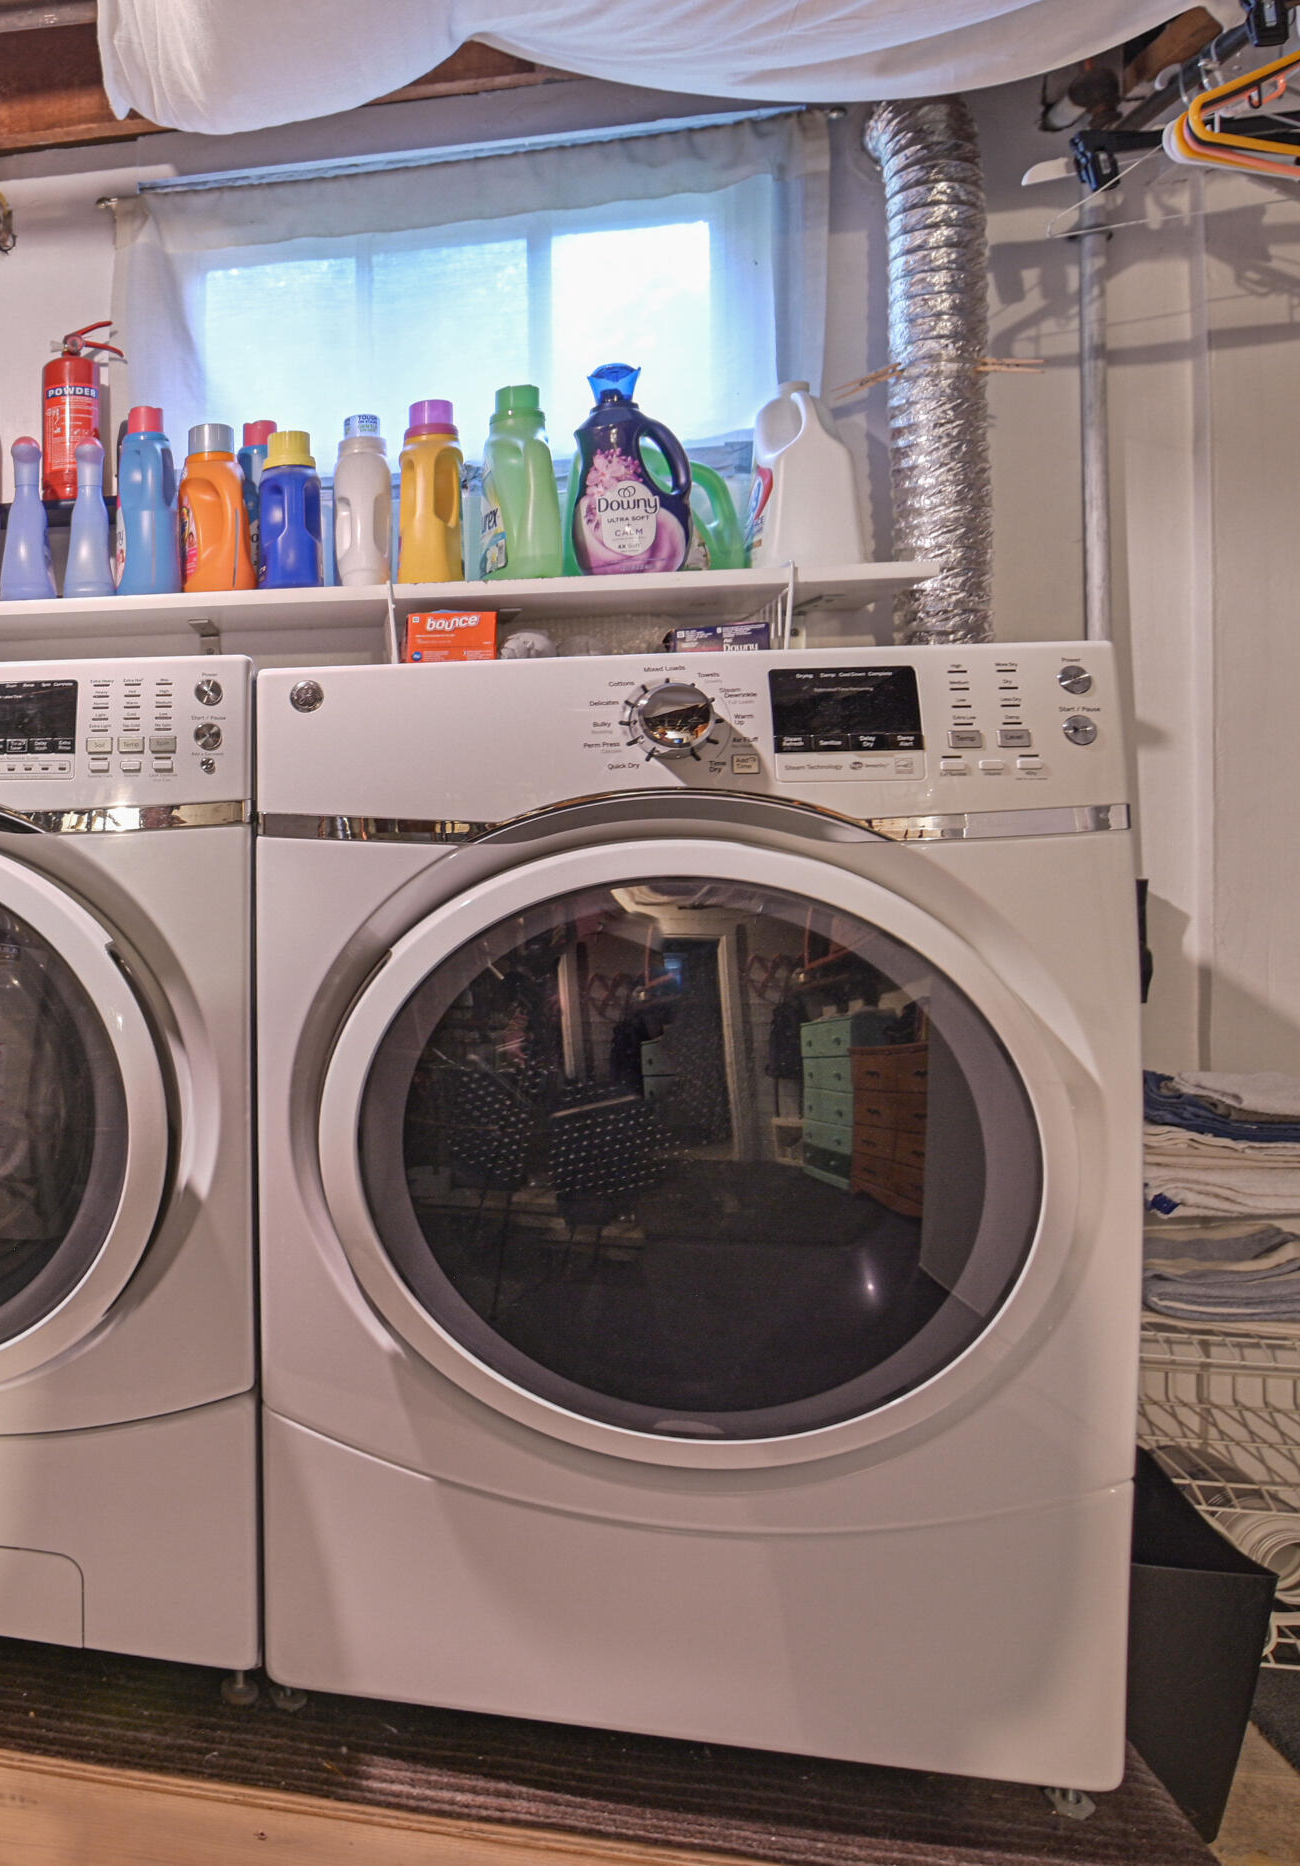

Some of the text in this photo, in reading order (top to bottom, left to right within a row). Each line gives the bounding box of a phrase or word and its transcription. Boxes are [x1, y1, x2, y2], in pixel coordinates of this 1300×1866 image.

[48, 386, 96, 397] POWDER
[597, 497, 658, 515] Downy
[426, 615, 480, 632] bounce
